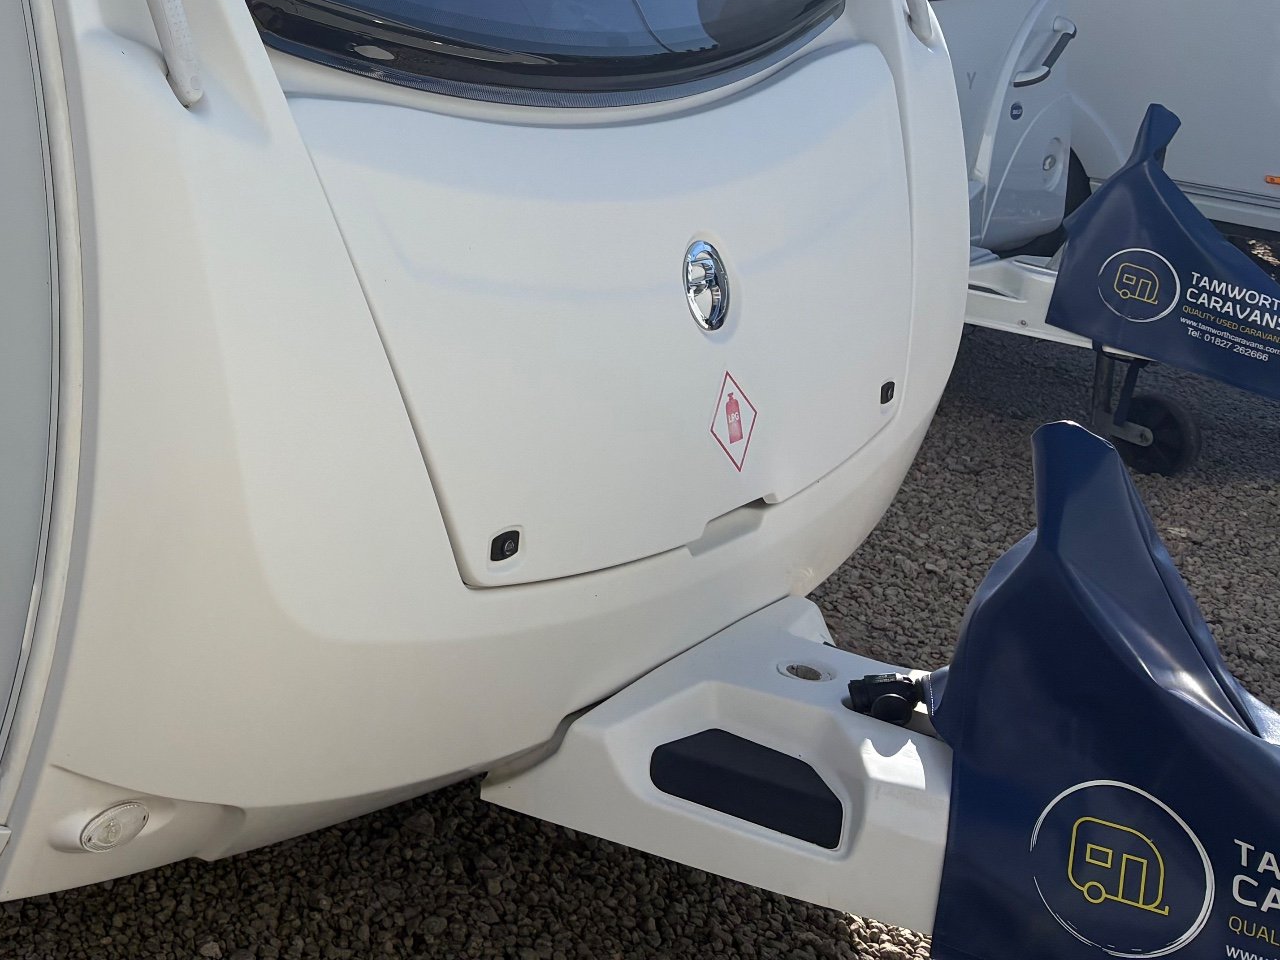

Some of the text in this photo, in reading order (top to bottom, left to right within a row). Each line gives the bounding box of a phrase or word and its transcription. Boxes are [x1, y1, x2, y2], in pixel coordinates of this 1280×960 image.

[1182, 305, 1216, 321] QUALITY
[1216, 317, 1239, 330] USED
[1187, 327, 1269, 361] Tel: 01827 262666
